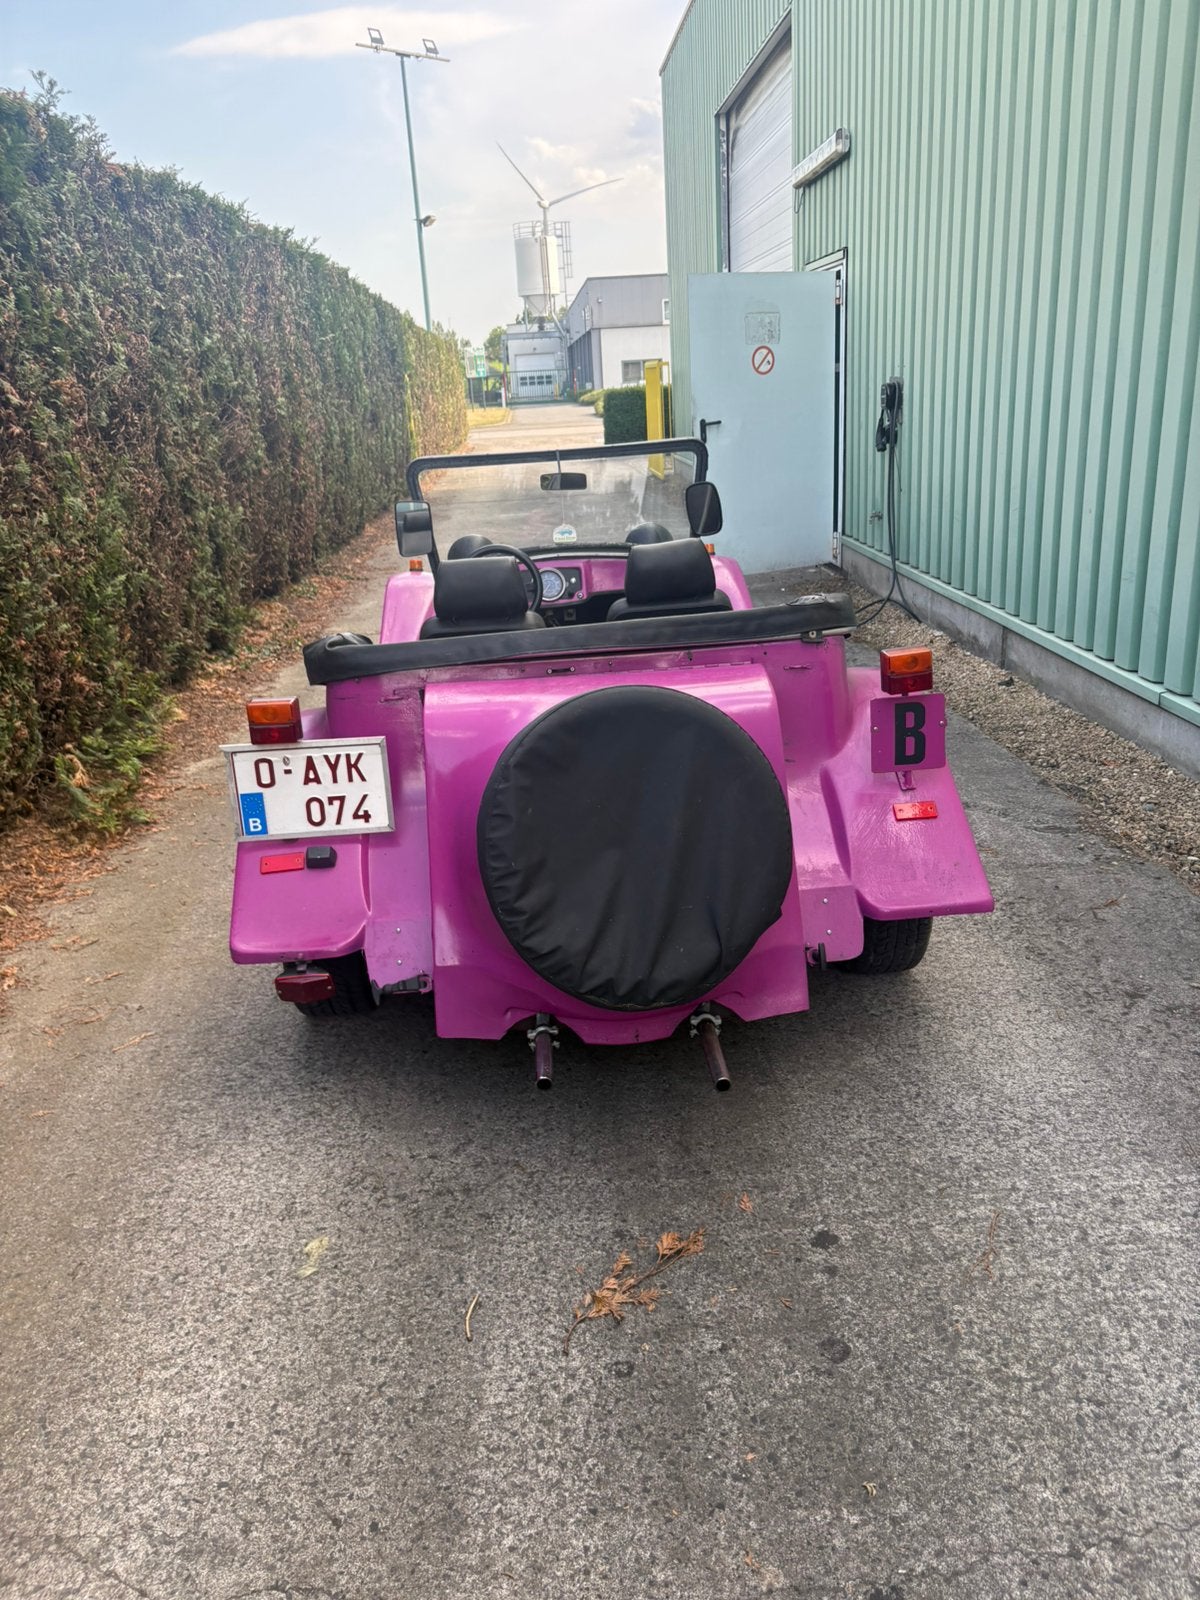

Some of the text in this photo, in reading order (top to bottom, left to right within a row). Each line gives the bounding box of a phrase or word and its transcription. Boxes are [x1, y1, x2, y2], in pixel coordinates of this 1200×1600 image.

[894, 701, 926, 766] B
[248, 817, 263, 832] B
[305, 794, 372, 827] 074
